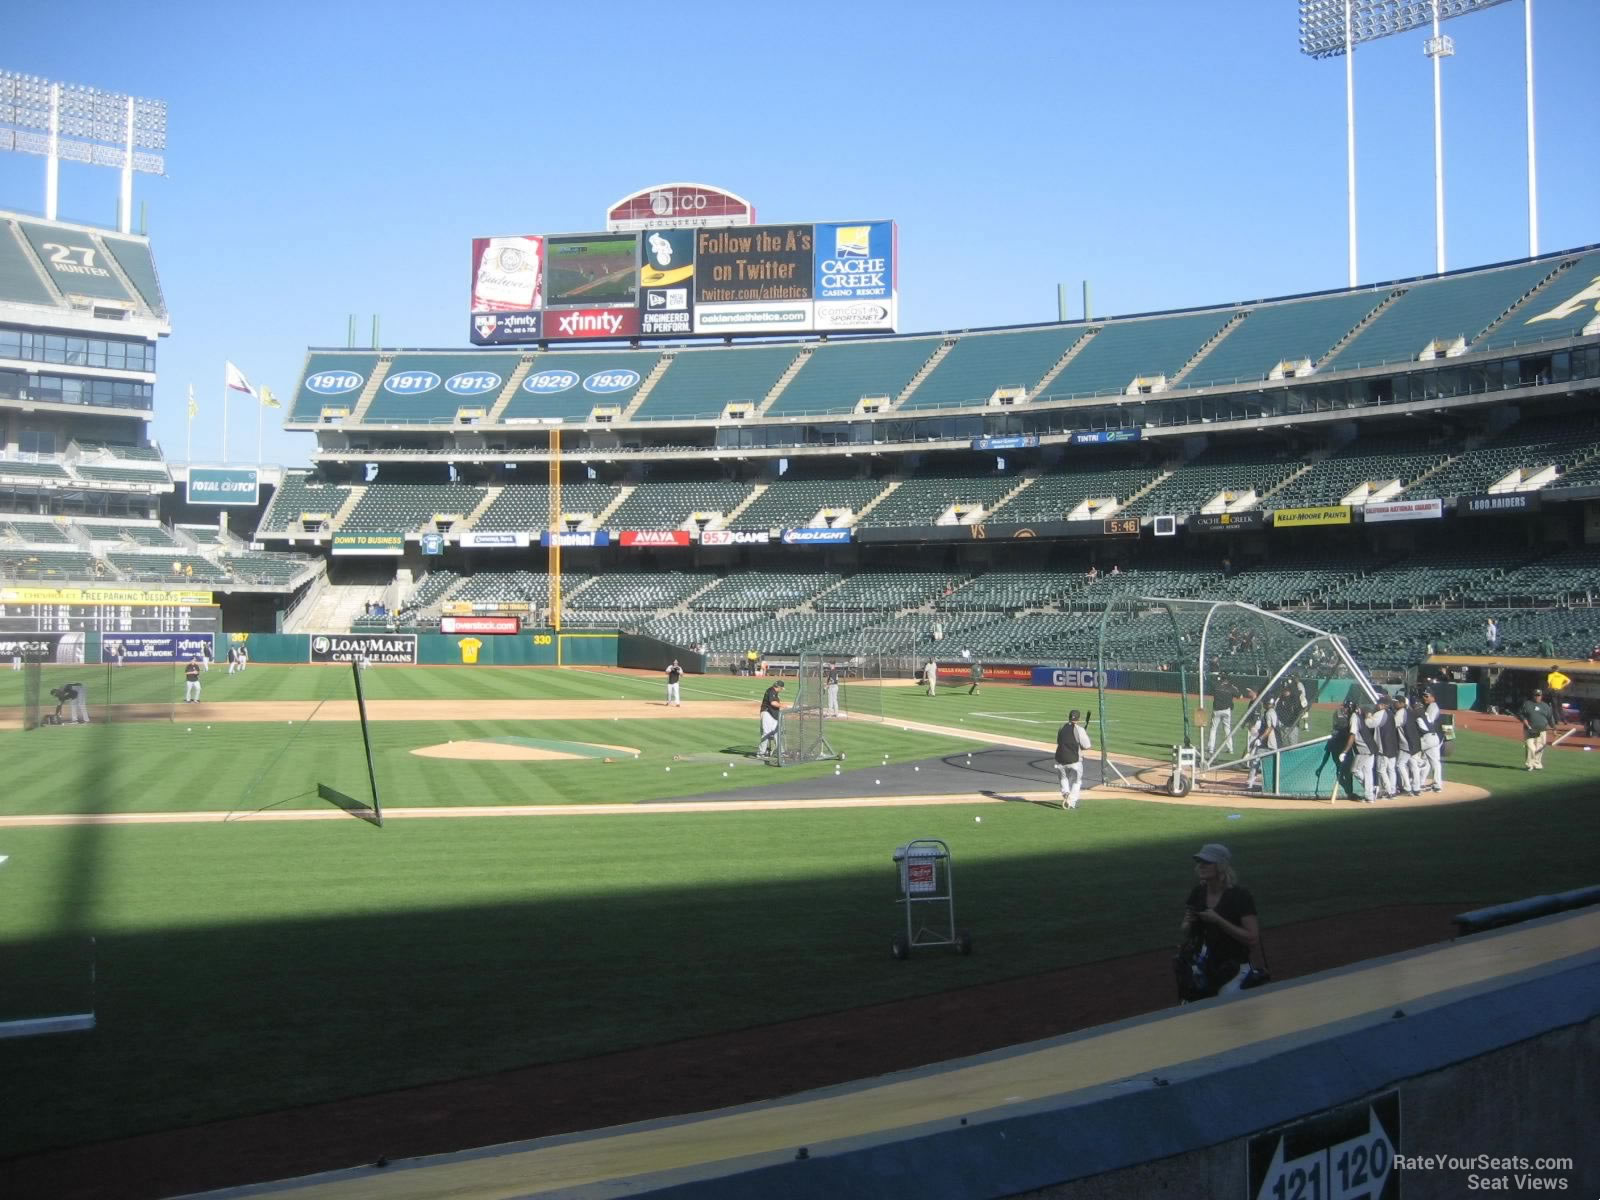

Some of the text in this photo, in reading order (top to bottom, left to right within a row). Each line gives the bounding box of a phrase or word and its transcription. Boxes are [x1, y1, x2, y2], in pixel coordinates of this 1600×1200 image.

[700, 230, 811, 255] Follow the A's
[42, 243, 96, 267] 27
[53, 263, 112, 278] HUNTER
[713, 259, 796, 281] on Twitter
[821, 258, 885, 274] CACHE
[821, 273, 886, 288] CREEK
[702, 284, 808, 301] twitter.com/athletics
[822, 288, 886, 297] CASINO RESORT
[644, 313, 690, 323] ENGINEERED
[701, 312, 804, 323] oaklandathletics.com
[642, 323, 652, 333] TO
[313, 376, 358, 389] 1910
[391, 376, 433, 389] 1911
[452, 376, 496, 389] 1913
[531, 375, 573, 388] 1929
[591, 374, 633, 387] 1930
[1077, 434, 1099, 442] TINTRI
[192, 481, 220, 491] TOTAL
[1277, 511, 1347, 522] KELLY-MOORE PAINTS
[635, 531, 675, 542] AVAYA
[703, 532, 730, 543] 95.7
[735, 532, 769, 543] GAME
[813, 531, 847, 540] LIGHT
[971, 524, 985, 539] VS
[81, 592, 103, 600] FREE
[103, 592, 138, 601] PARKING
[141, 592, 178, 602] TUESDAYS
[533, 635, 552, 645] 330
[382, 654, 412, 662] LOANS
[1052, 670, 1107, 688] GEICO
[1337, 1138, 1387, 1192] 120
[1273, 1161, 1320, 1200] 121
